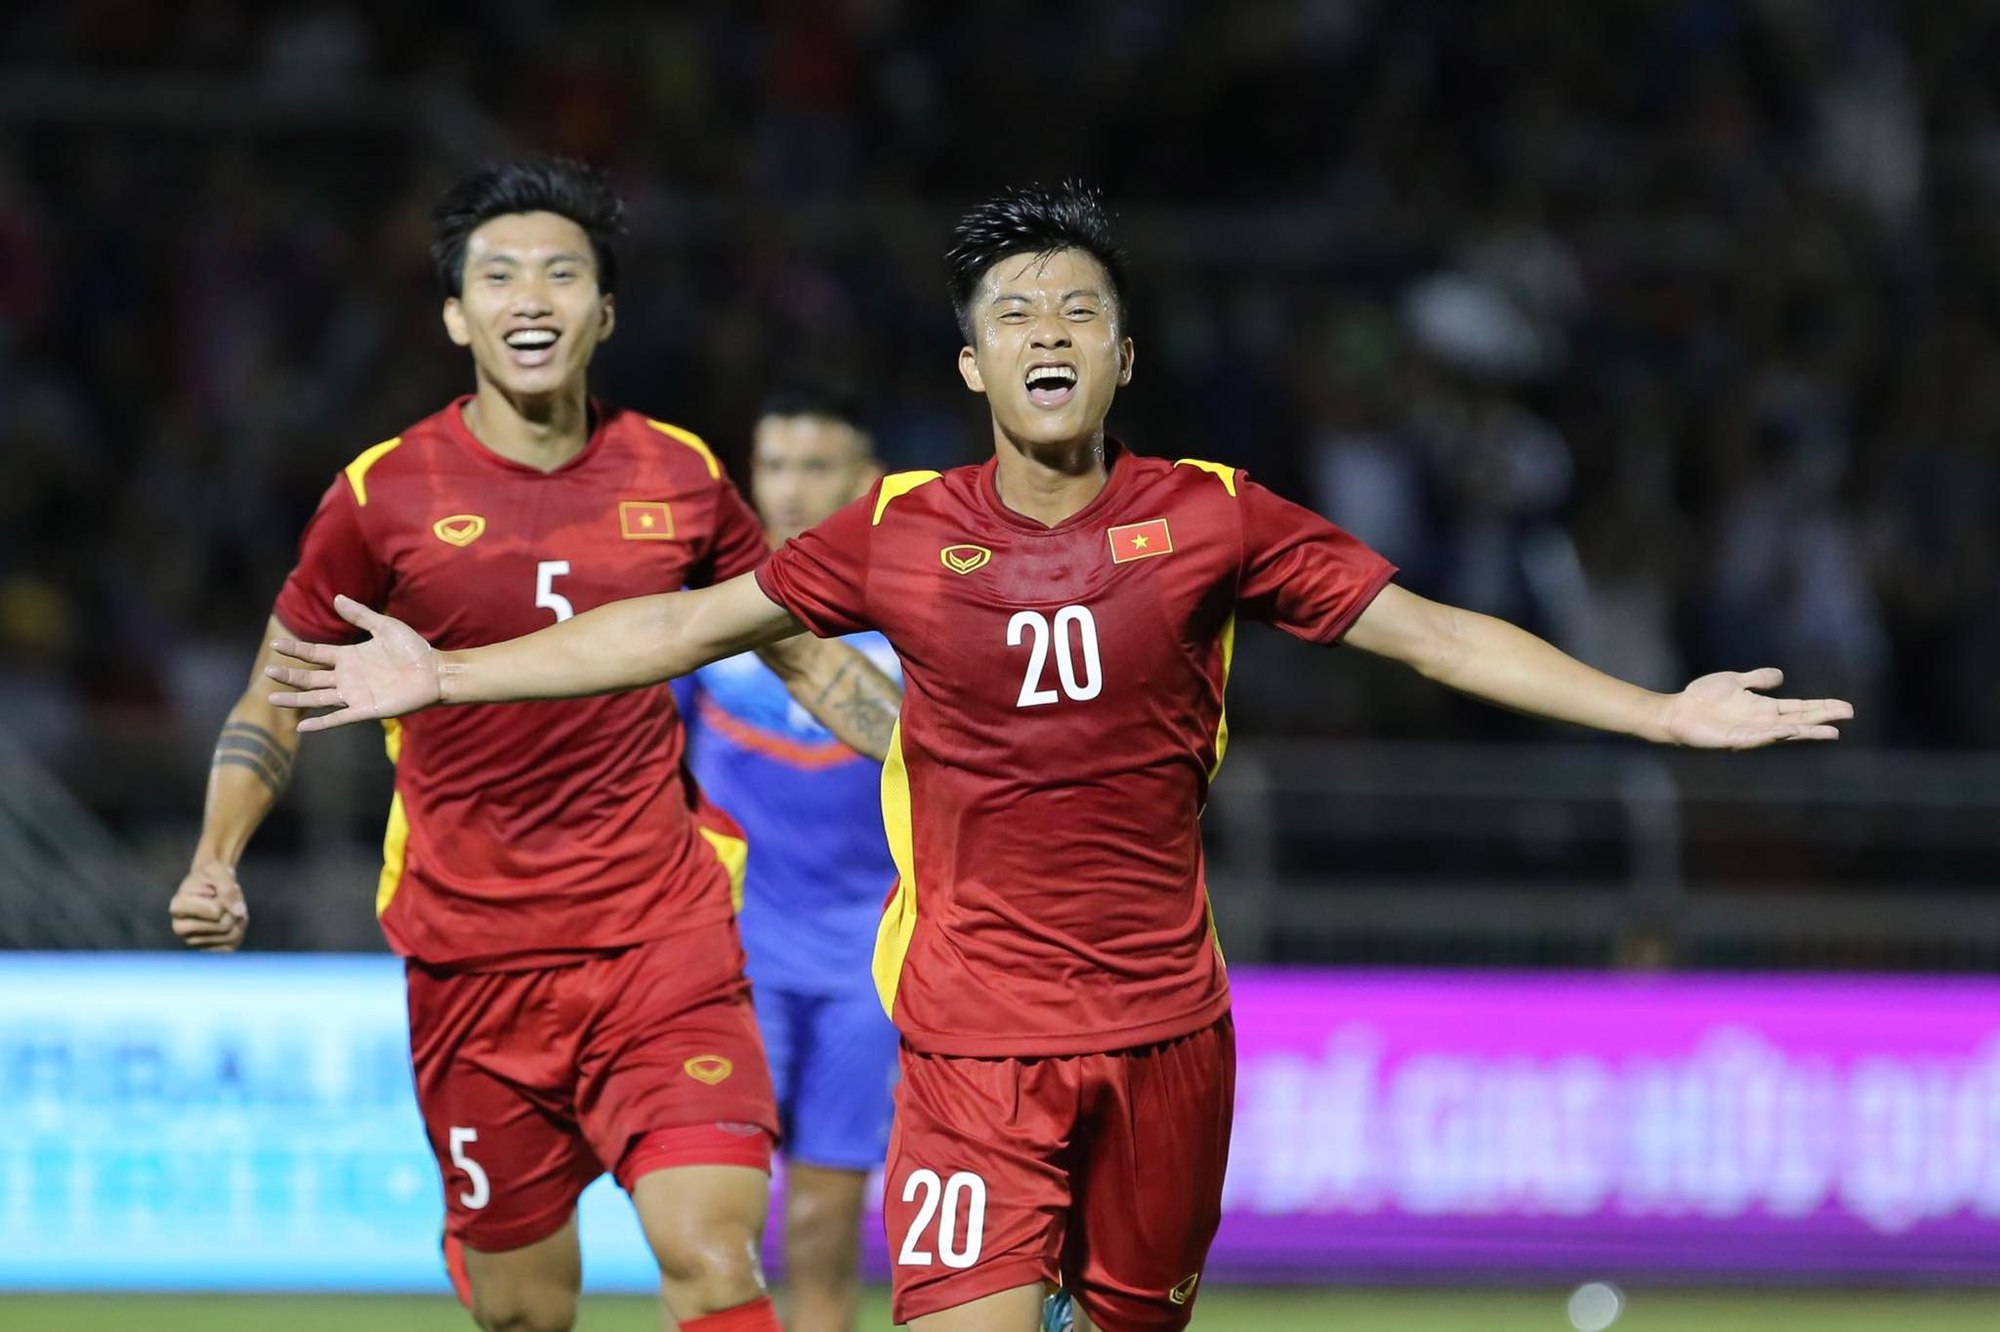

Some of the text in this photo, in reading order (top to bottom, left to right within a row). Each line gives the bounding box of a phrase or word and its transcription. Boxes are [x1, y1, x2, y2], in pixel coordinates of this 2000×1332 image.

[535, 560, 574, 623] 5
[1006, 604, 1103, 708] 20
[448, 1127, 491, 1210] 5
[899, 1168, 987, 1269] 20
